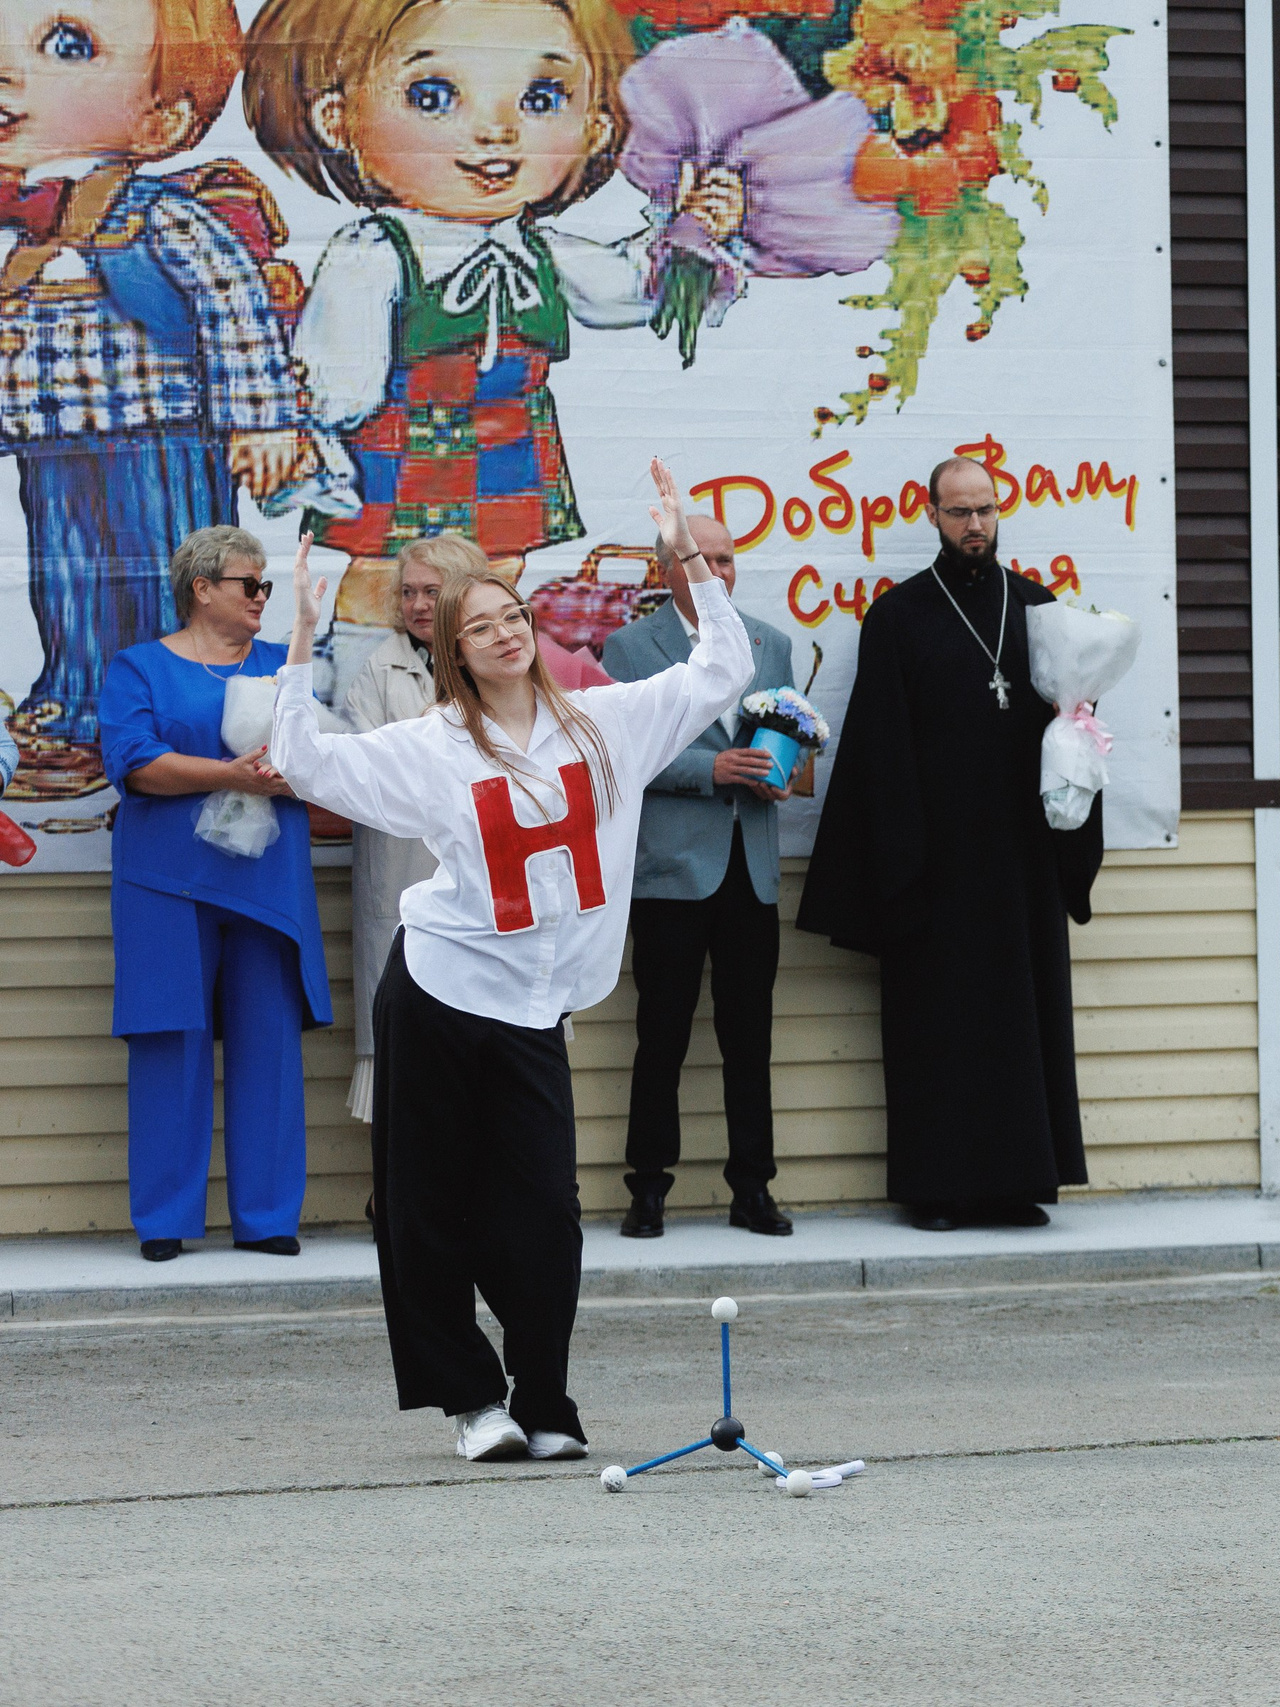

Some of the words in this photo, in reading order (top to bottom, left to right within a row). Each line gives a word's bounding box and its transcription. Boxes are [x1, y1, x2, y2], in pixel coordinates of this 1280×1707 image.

[689, 449, 930, 562] Добра
[954, 433, 1139, 532] Вам,
[470, 760, 607, 933] Н
